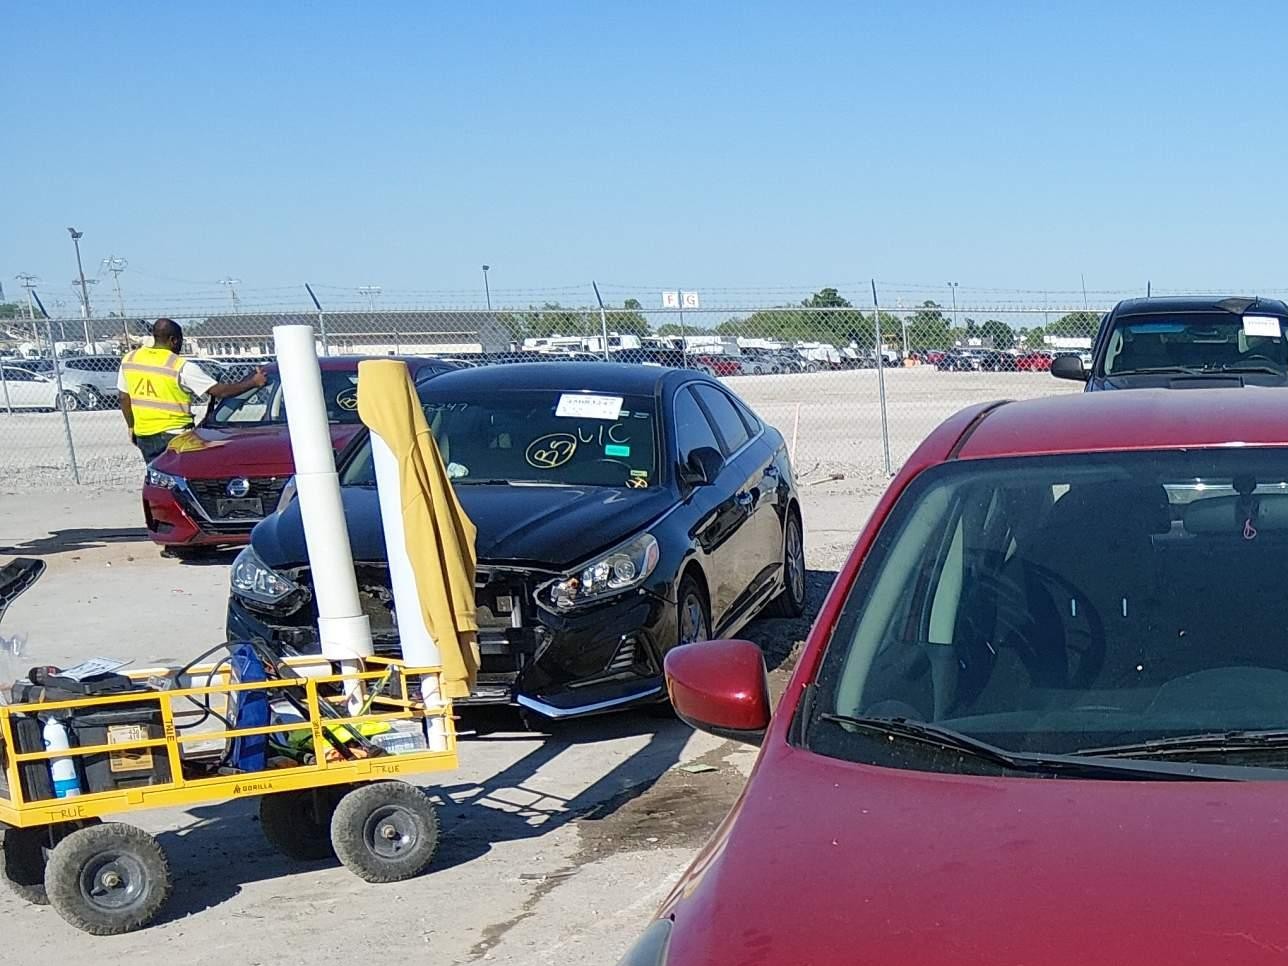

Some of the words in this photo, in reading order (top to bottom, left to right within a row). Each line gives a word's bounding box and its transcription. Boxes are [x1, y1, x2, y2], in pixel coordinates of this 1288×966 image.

[373, 764, 401, 775] TRUE
[242, 783, 273, 792] GORILLA
[44, 806, 88, 821] TRUE
